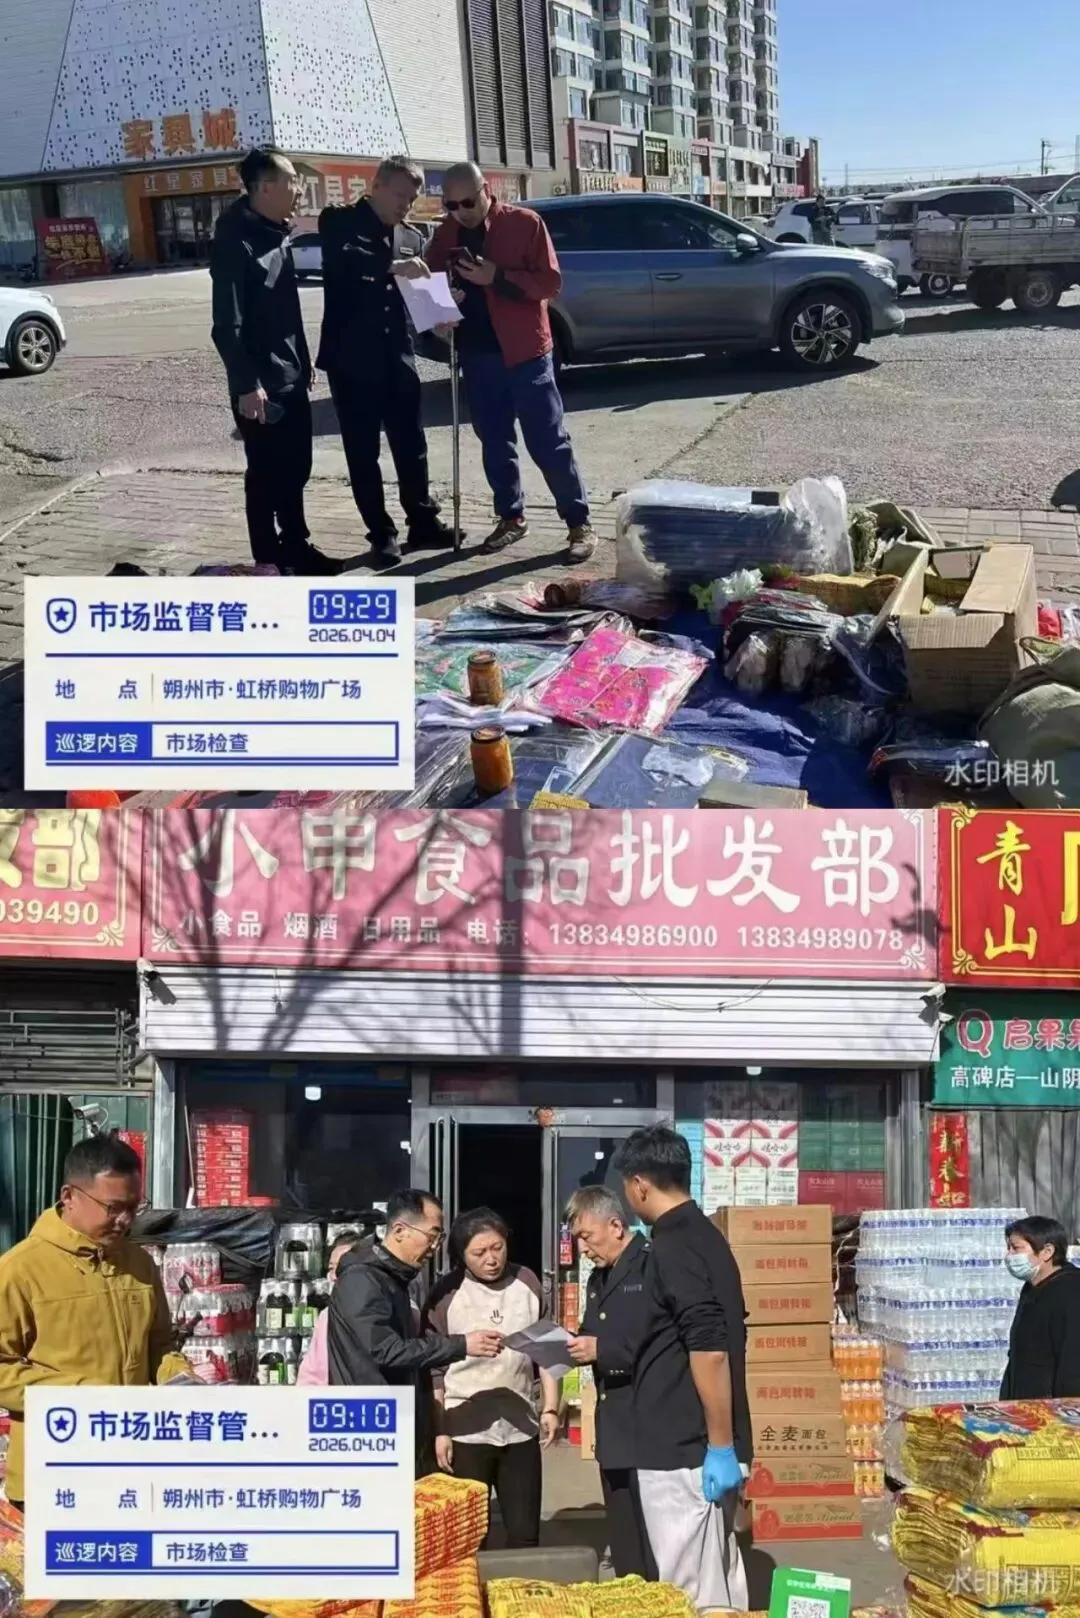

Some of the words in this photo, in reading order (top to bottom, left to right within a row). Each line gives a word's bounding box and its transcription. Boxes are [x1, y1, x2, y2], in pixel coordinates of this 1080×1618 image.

[179, 909, 262, 938] 小食品
[284, 911, 338, 940] 烟酒
[363, 915, 440, 943] 日用品
[550, 923, 717, 947] 13834986900
[737, 926, 904, 950] 13834989078
[976, 820, 1037, 960] 青山
